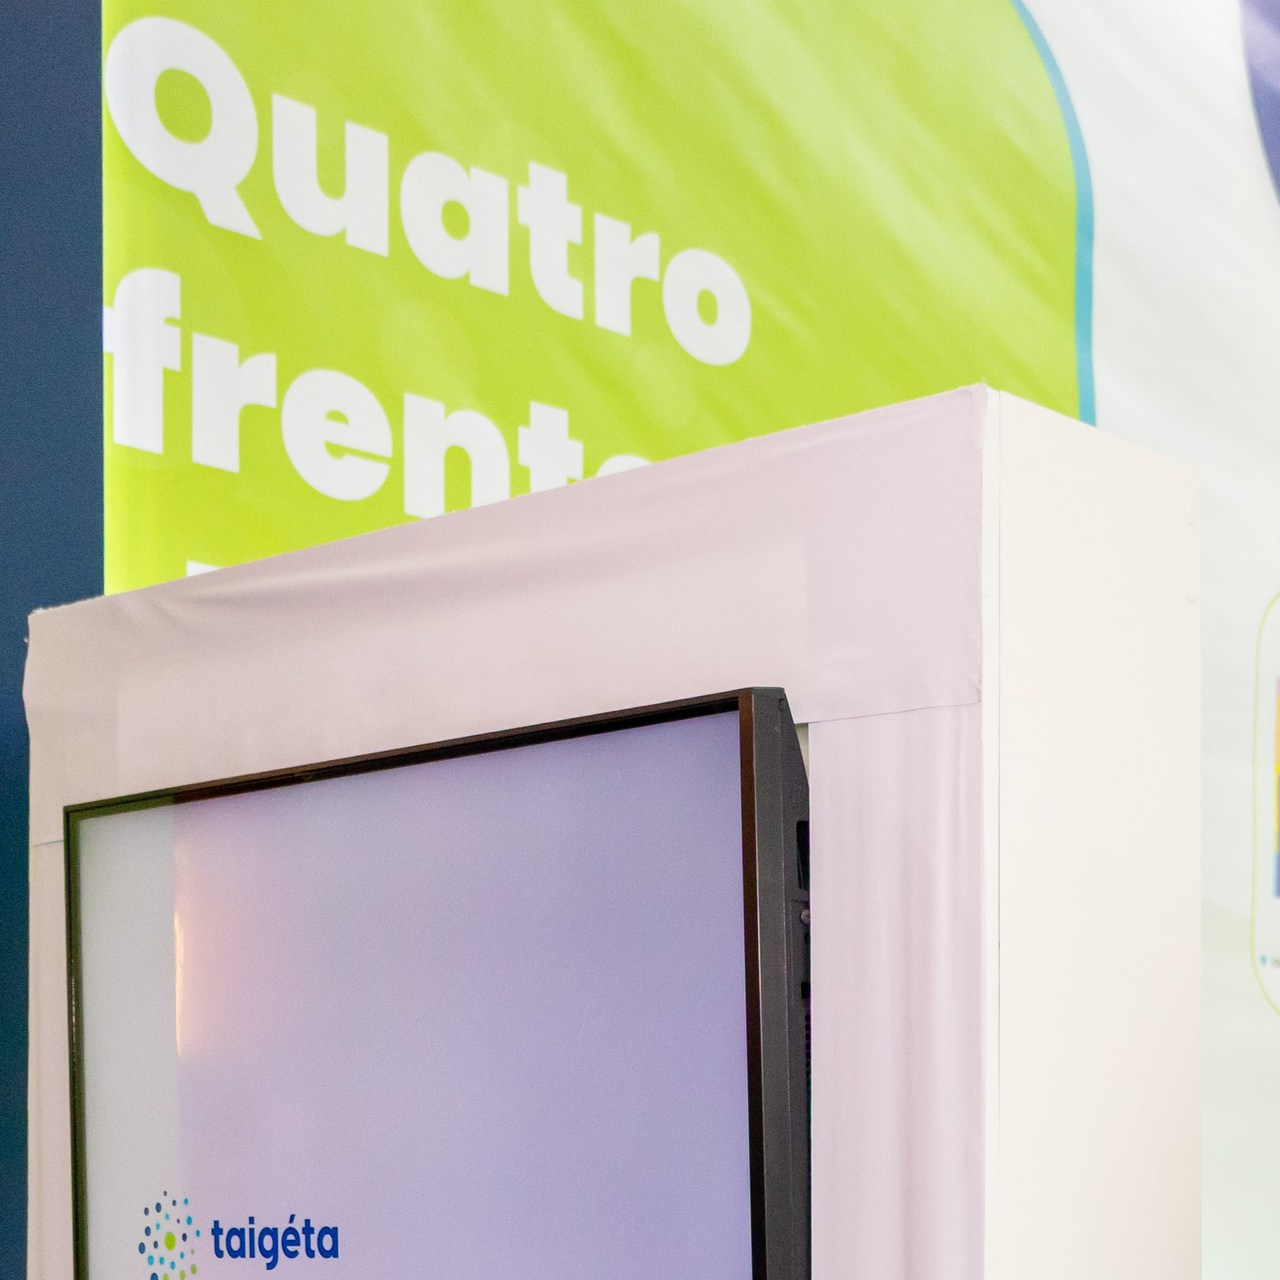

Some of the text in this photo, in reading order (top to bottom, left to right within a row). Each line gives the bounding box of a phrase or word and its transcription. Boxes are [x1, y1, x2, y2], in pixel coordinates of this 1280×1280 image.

[104, 15, 752, 366] Quatro
[103, 267, 655, 520] frent
[211, 1214, 339, 1270] taigéta
